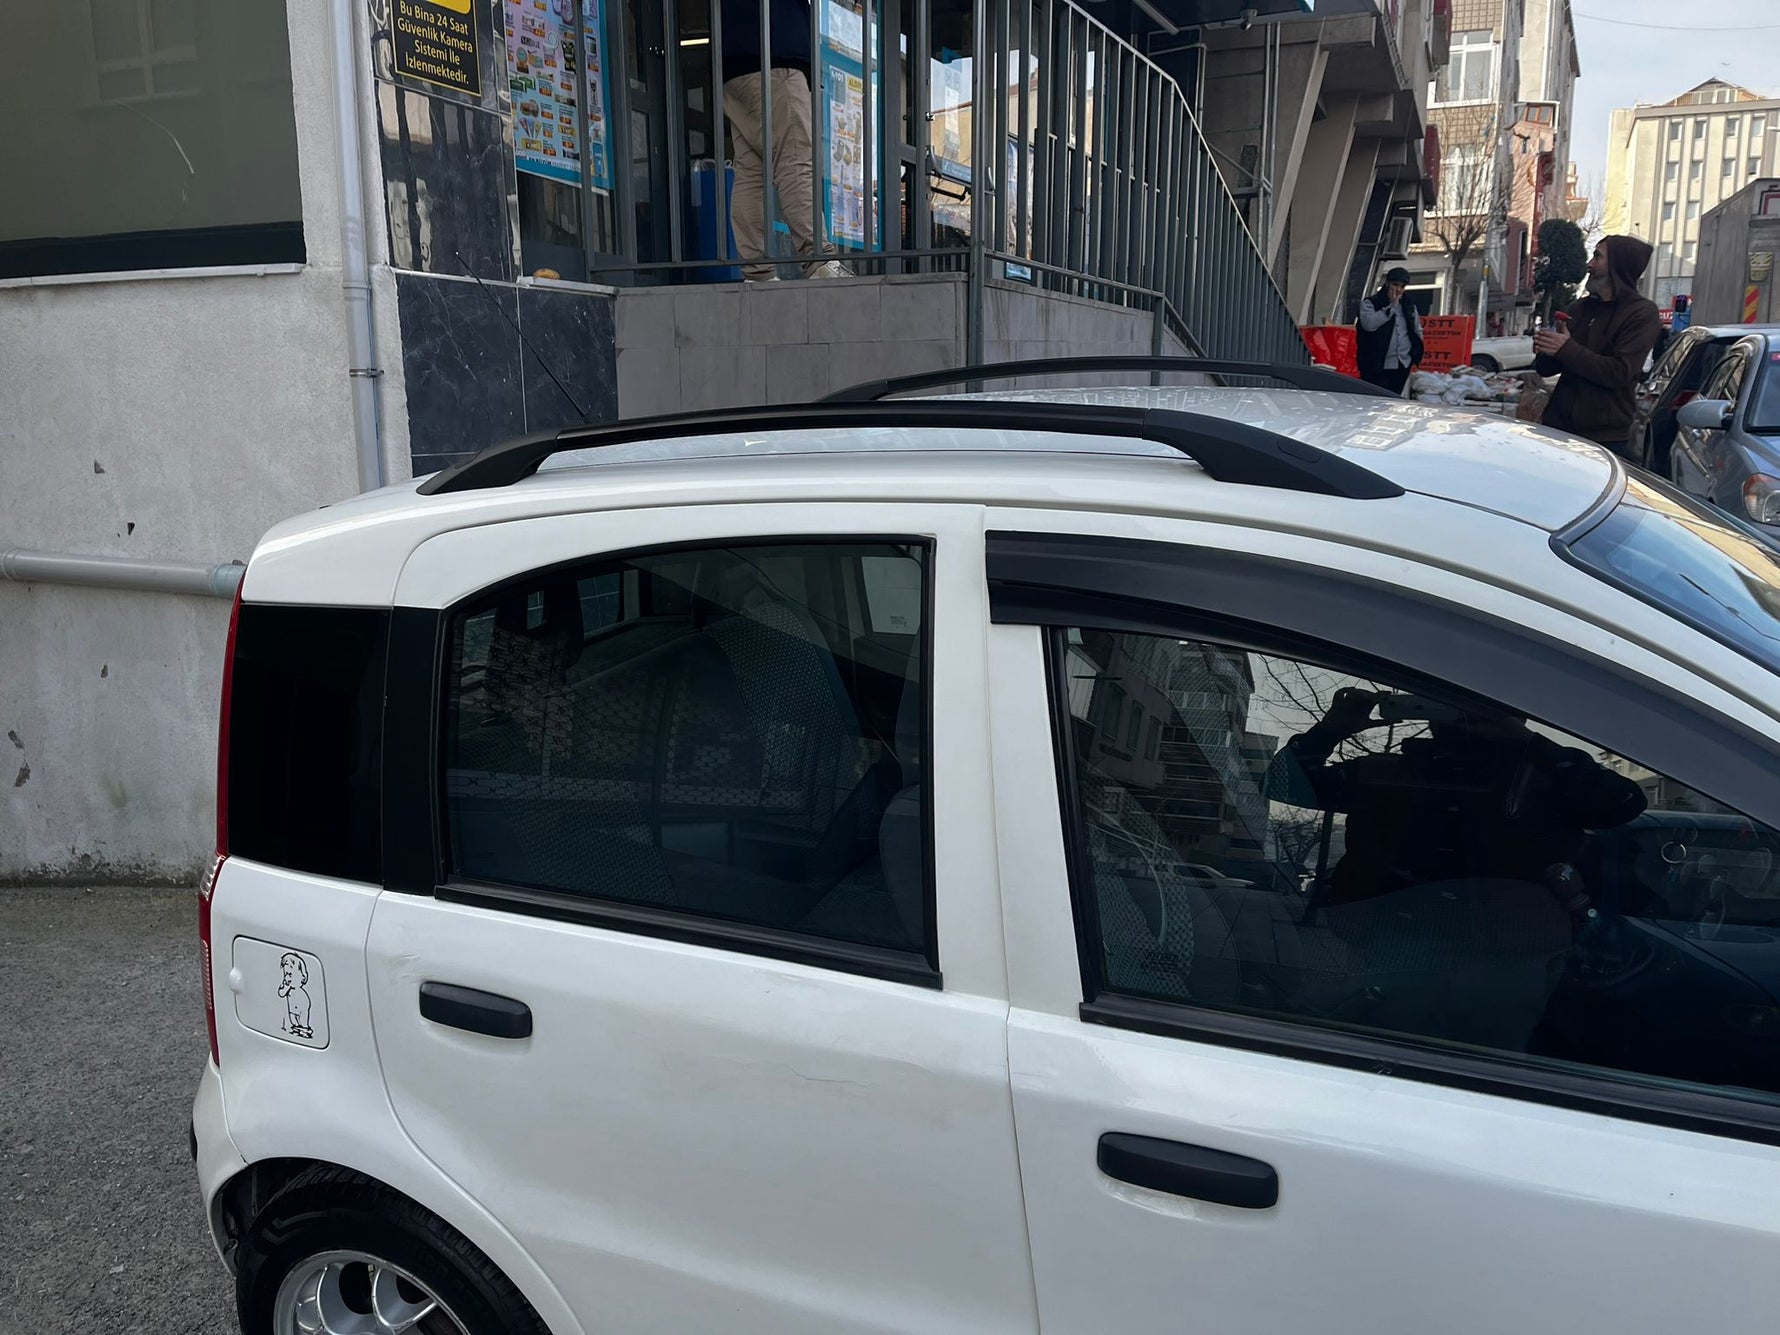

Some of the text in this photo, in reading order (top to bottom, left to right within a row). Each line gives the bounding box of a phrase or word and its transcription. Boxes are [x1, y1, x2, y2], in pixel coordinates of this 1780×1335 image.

[400, 1, 468, 35] Bu Bina 24 Saat
[397, 17, 473, 53] Güvenlik Kamera
[414, 39, 448, 61] Sistemi
[405, 51, 469, 84] Izlenmektedir.
